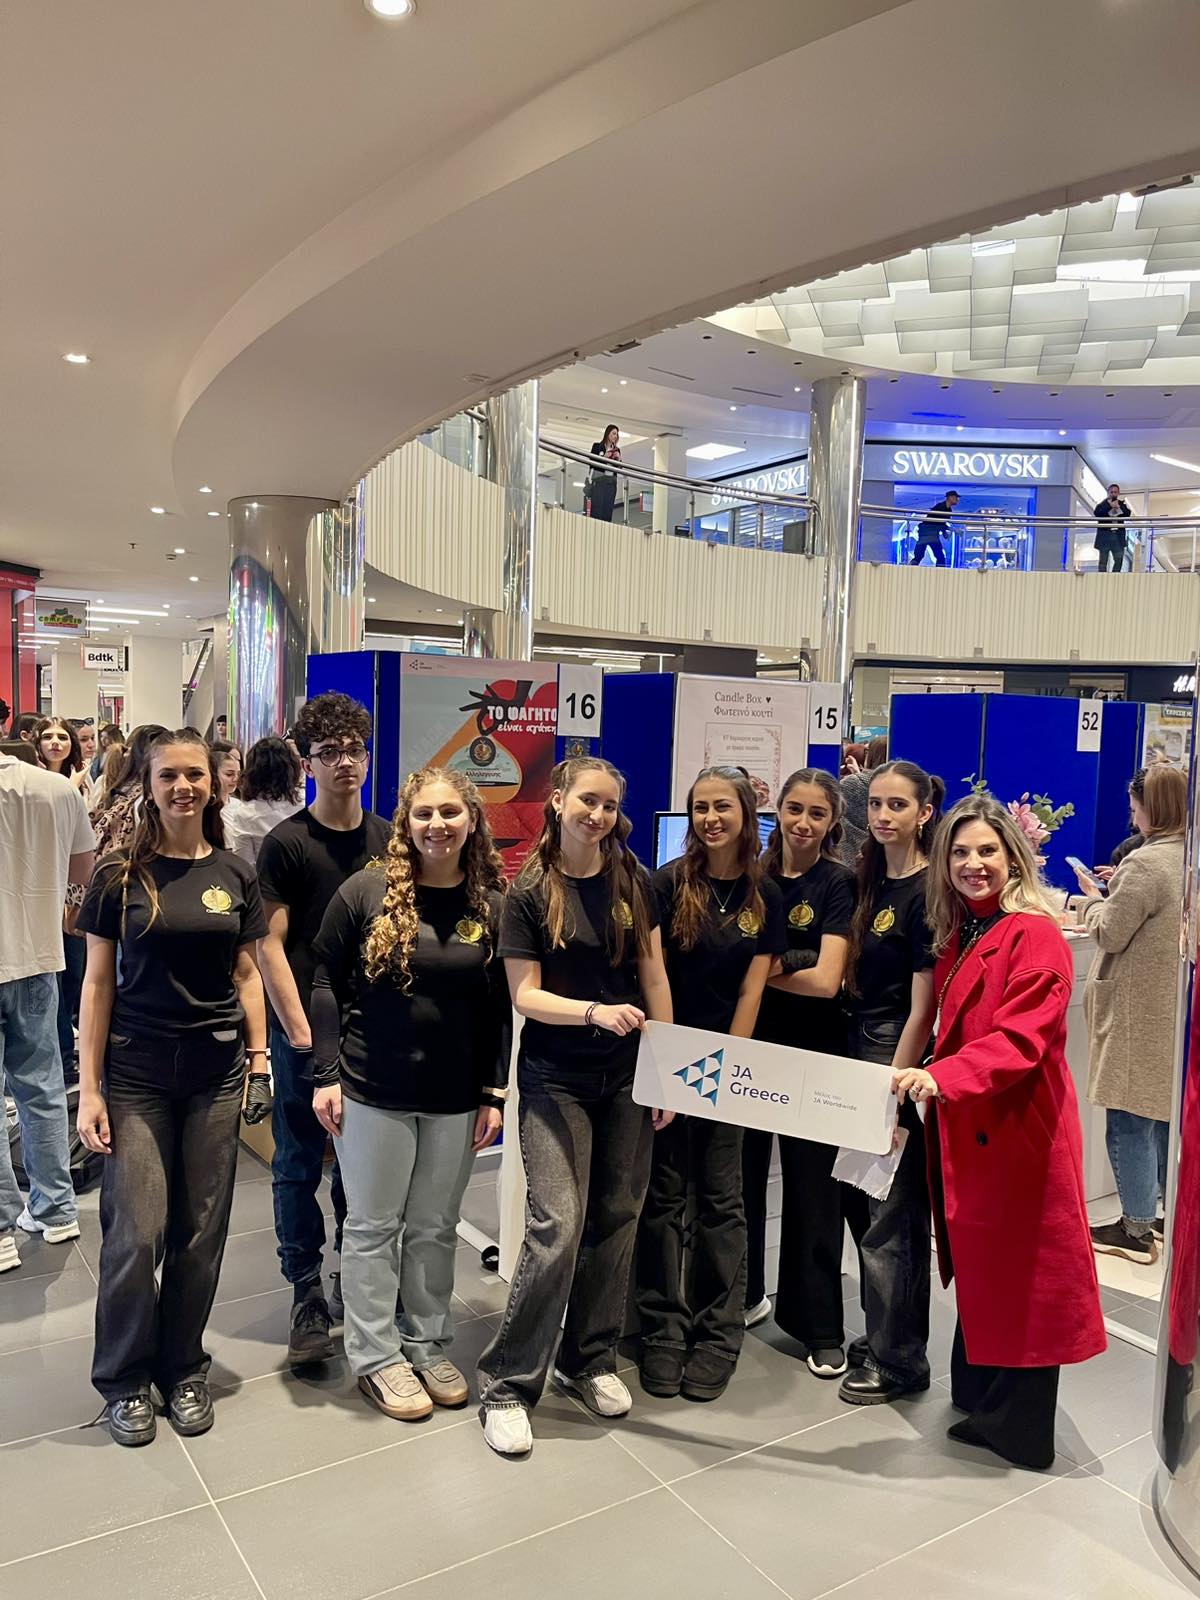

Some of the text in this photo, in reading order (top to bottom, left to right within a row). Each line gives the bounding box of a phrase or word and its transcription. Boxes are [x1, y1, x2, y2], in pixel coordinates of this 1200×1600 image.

[892, 451, 1050, 478] SWAROVSKI
[88, 653, 114, 662] Bdtk
[714, 691, 763, 704] Candle Box
[487, 705, 505, 720] ΤΟ
[566, 693, 595, 720] 16
[713, 705, 774, 718] Φωτεινό κουτί
[815, 707, 837, 729] 15
[1081, 711, 1099, 731] 52
[497, 720, 523, 732] είναι
[731, 1065, 752, 1080] JA
[730, 1082, 789, 1105] Greece
